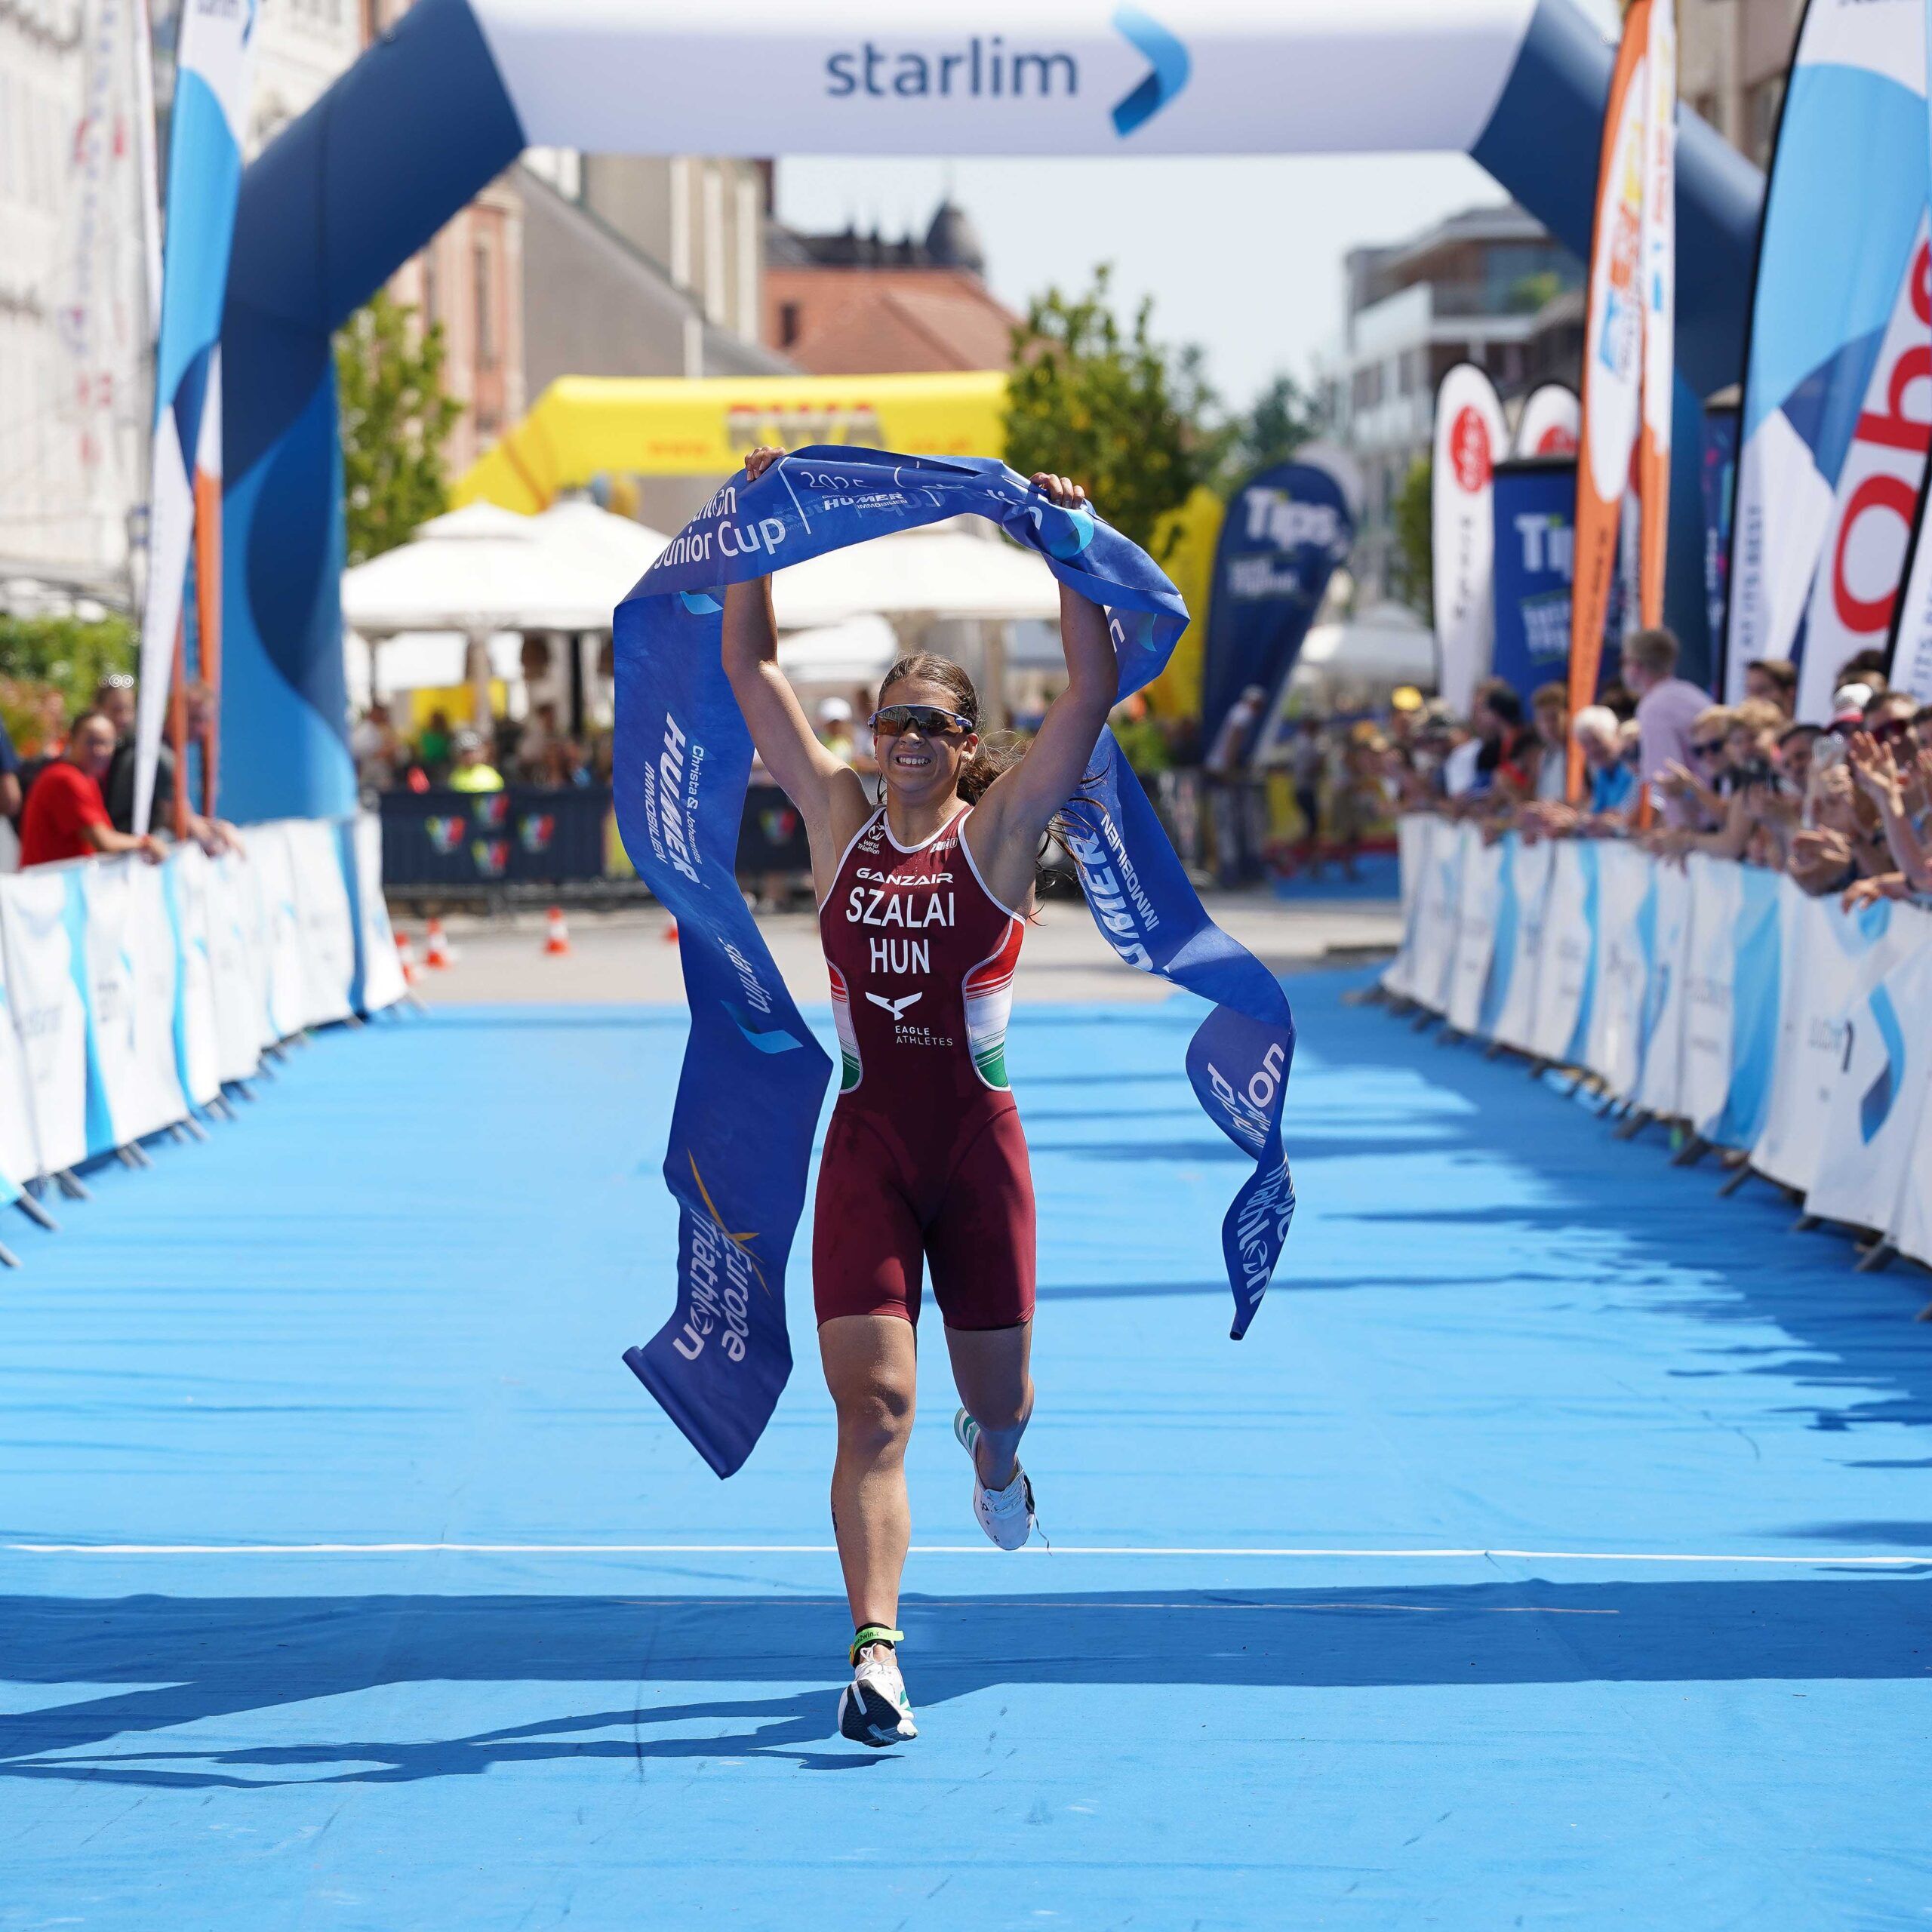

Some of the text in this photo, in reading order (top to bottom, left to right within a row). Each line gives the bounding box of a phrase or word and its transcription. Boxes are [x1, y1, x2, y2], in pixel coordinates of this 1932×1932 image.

[826, 35, 1078, 96] starlim
[824, 493, 904, 511] HUMER
[857, 500, 908, 509] IMMOBILIEN
[654, 526, 712, 570] Junior
[718, 518, 786, 557] Cup
[688, 745, 705, 795] Christa
[645, 761, 669, 864] IMMOBILIEN
[660, 712, 700, 883] HUMER
[687, 797, 699, 810] &
[857, 842, 880, 855] Triathlon
[863, 839, 879, 849] World
[856, 868, 953, 886] GANZAIR
[1100, 814, 1160, 932] IMMOBILIEN
[845, 886, 955, 928] SZALAI
[869, 937, 931, 974] HUN
[894, 1025, 931, 1035] EAGLE
[896, 1035, 954, 1047] ATHLETES
[672, 1208, 721, 1361] Triathlon
[720, 1230, 753, 1362] Europe
